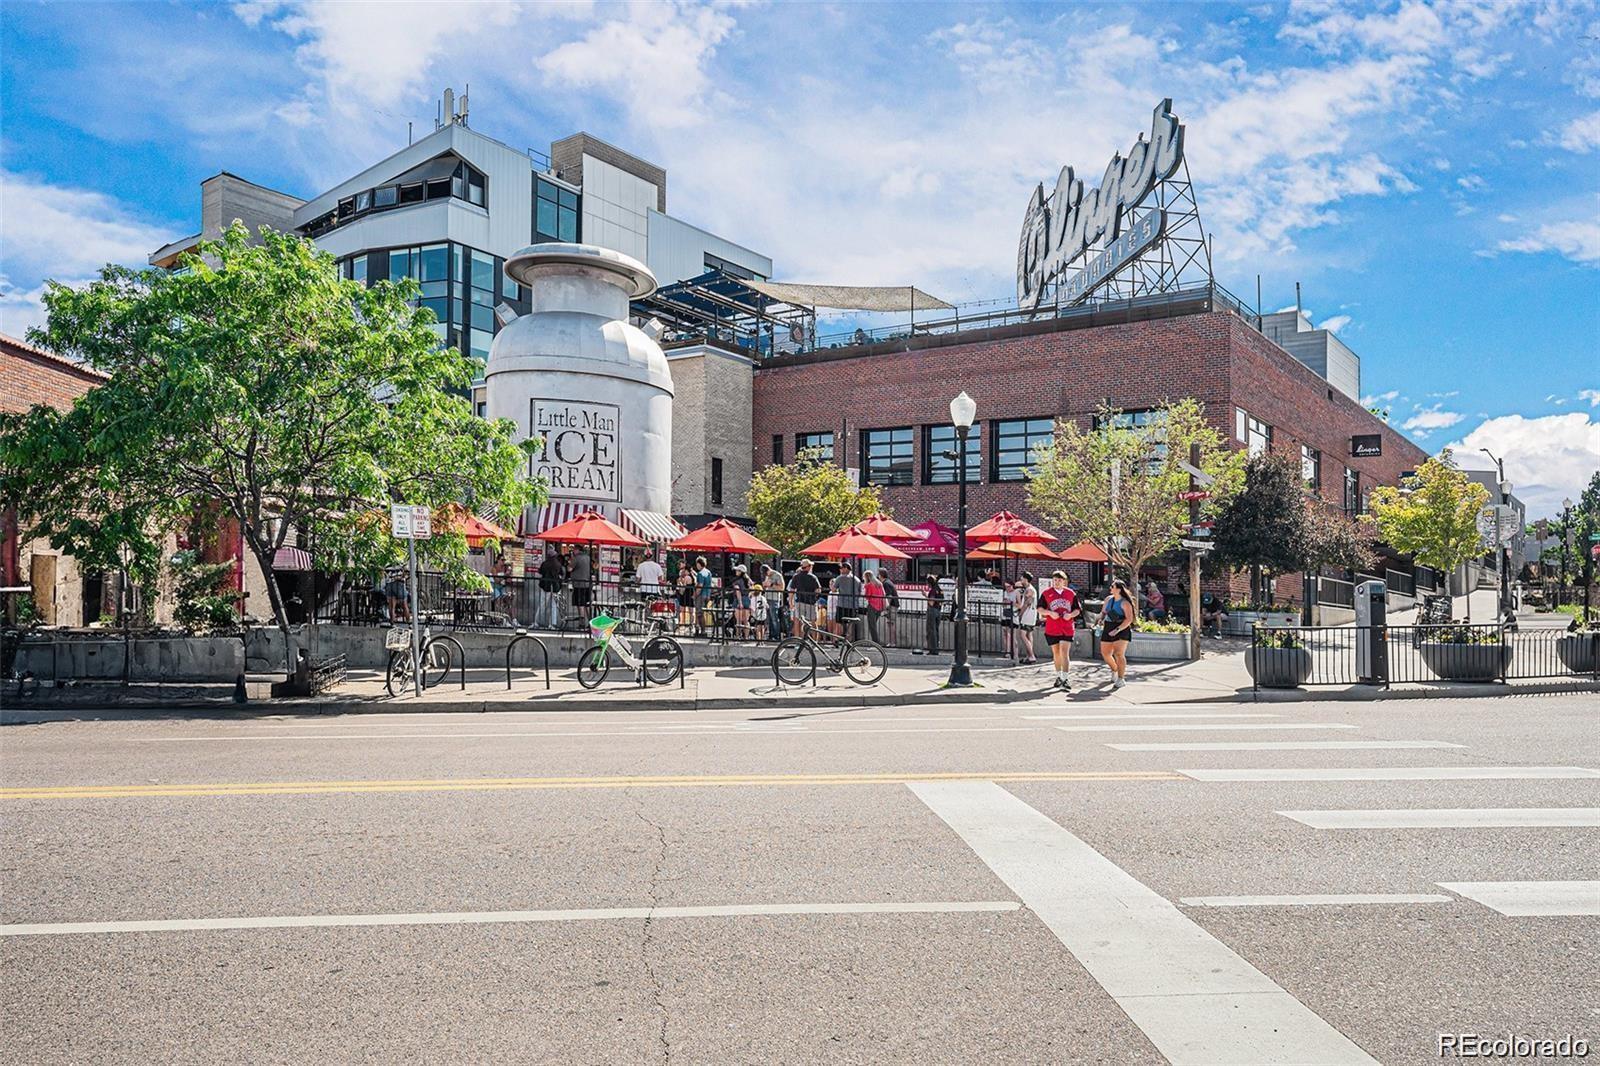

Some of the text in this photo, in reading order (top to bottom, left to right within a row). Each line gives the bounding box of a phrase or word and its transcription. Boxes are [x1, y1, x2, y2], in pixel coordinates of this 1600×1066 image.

[538, 407, 614, 431] Little Man
[538, 429, 614, 468] ICE
